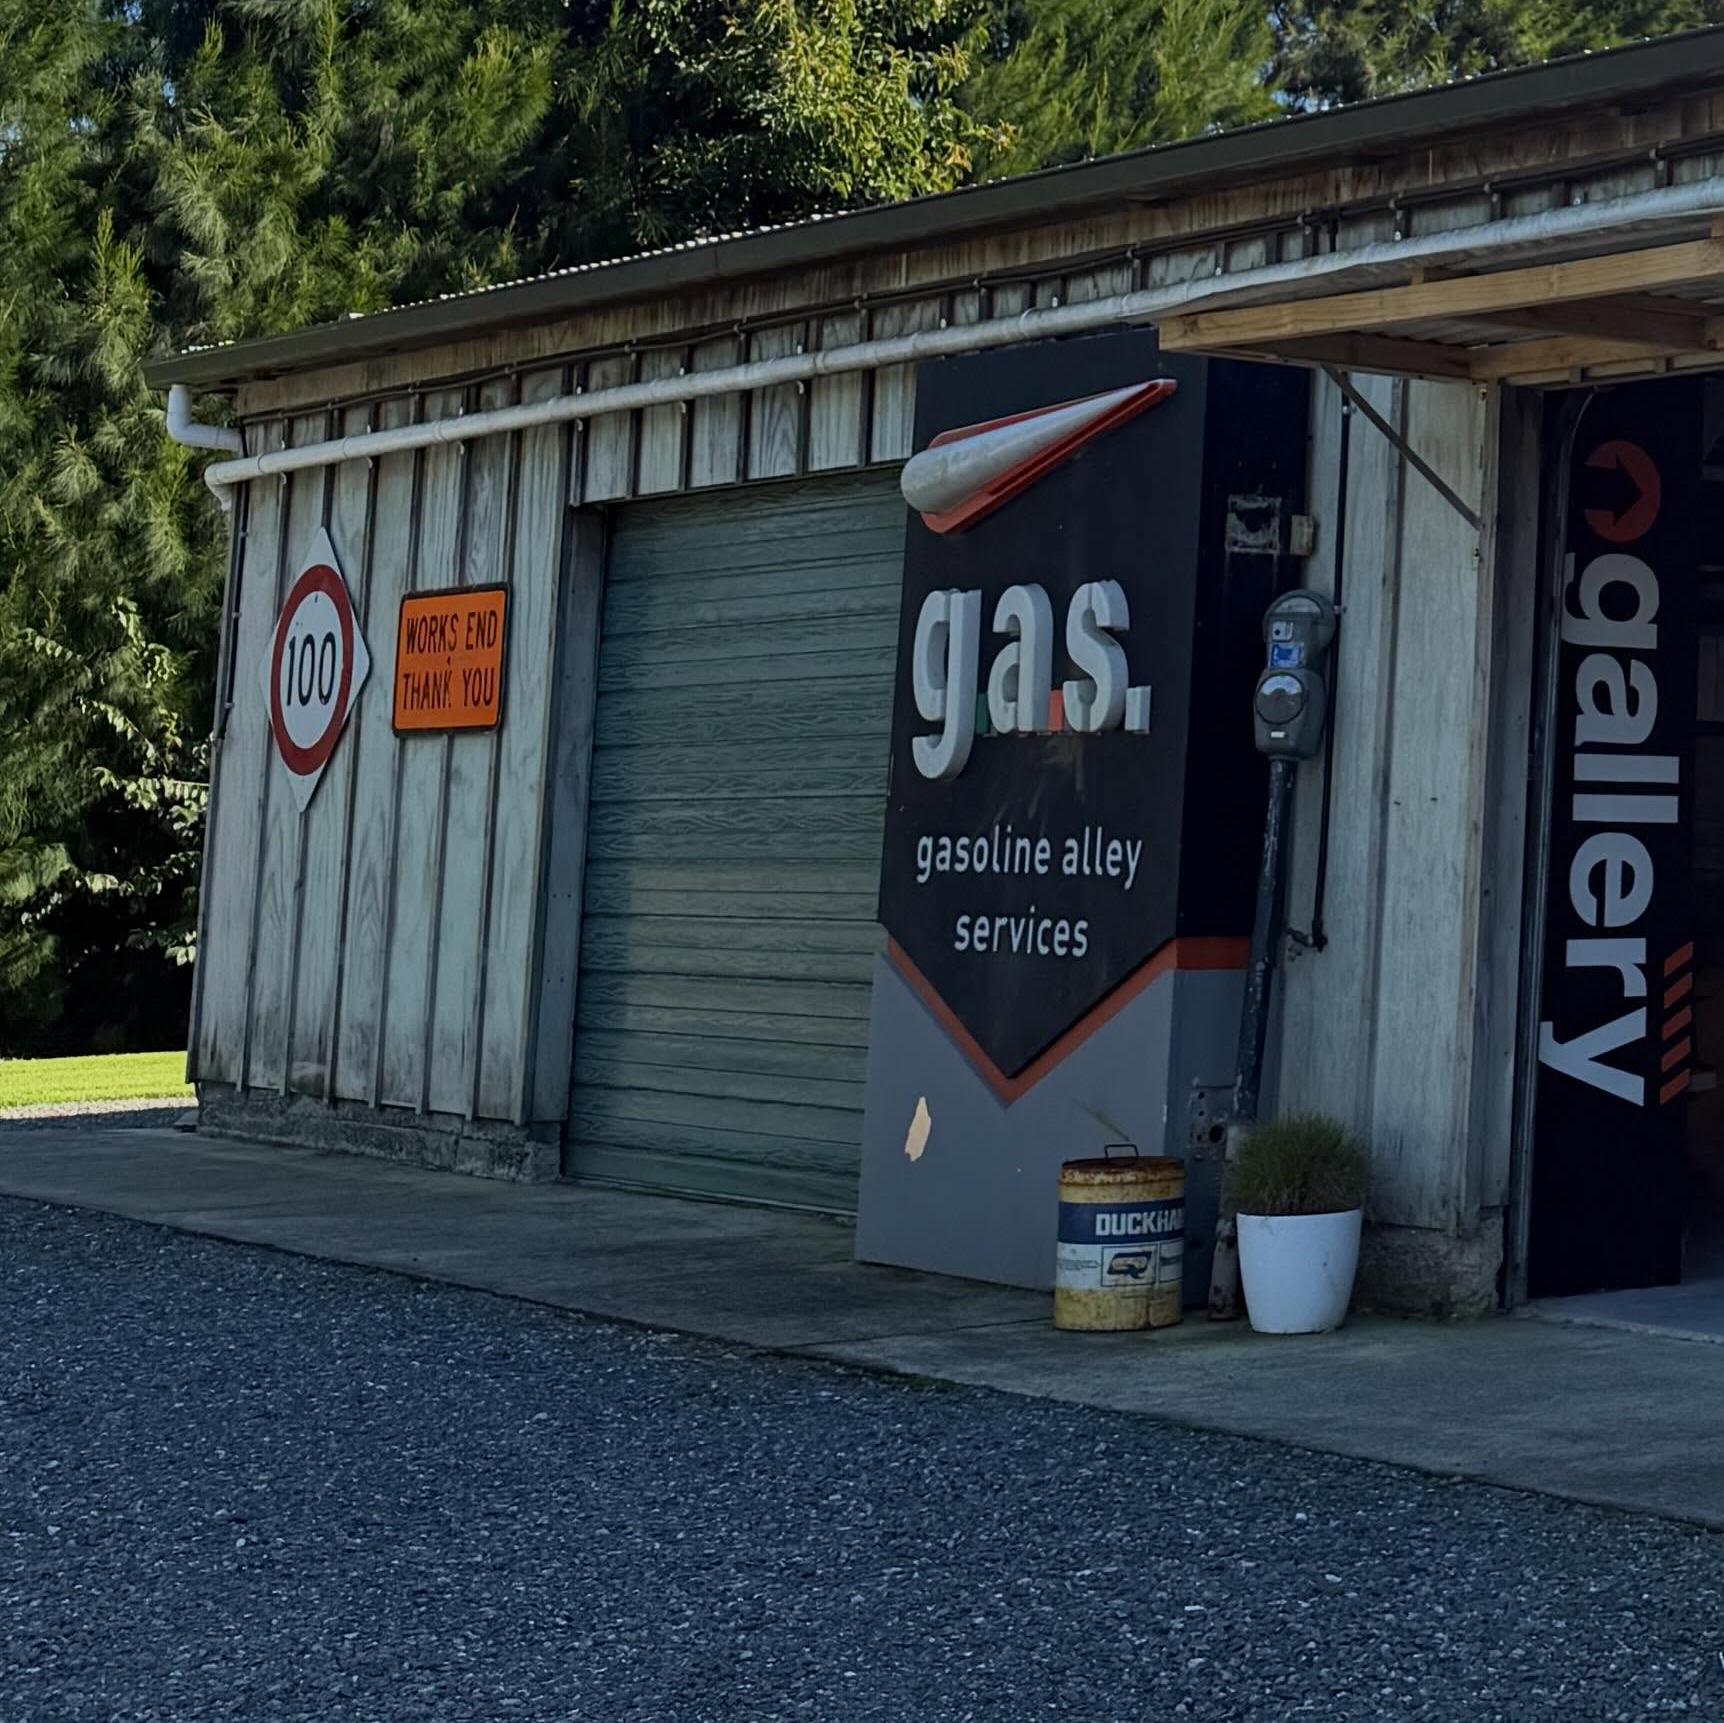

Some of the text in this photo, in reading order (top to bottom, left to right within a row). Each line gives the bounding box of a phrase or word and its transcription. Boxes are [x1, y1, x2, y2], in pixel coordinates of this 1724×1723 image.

[405, 610, 498, 654] WORKS END
[286, 631, 337, 707] 100
[402, 666, 495, 711] THANK YOU
[916, 824, 1143, 890] gasoline alley
[1538, 552, 1680, 1107] gallery
[953, 905, 1089, 957] services
